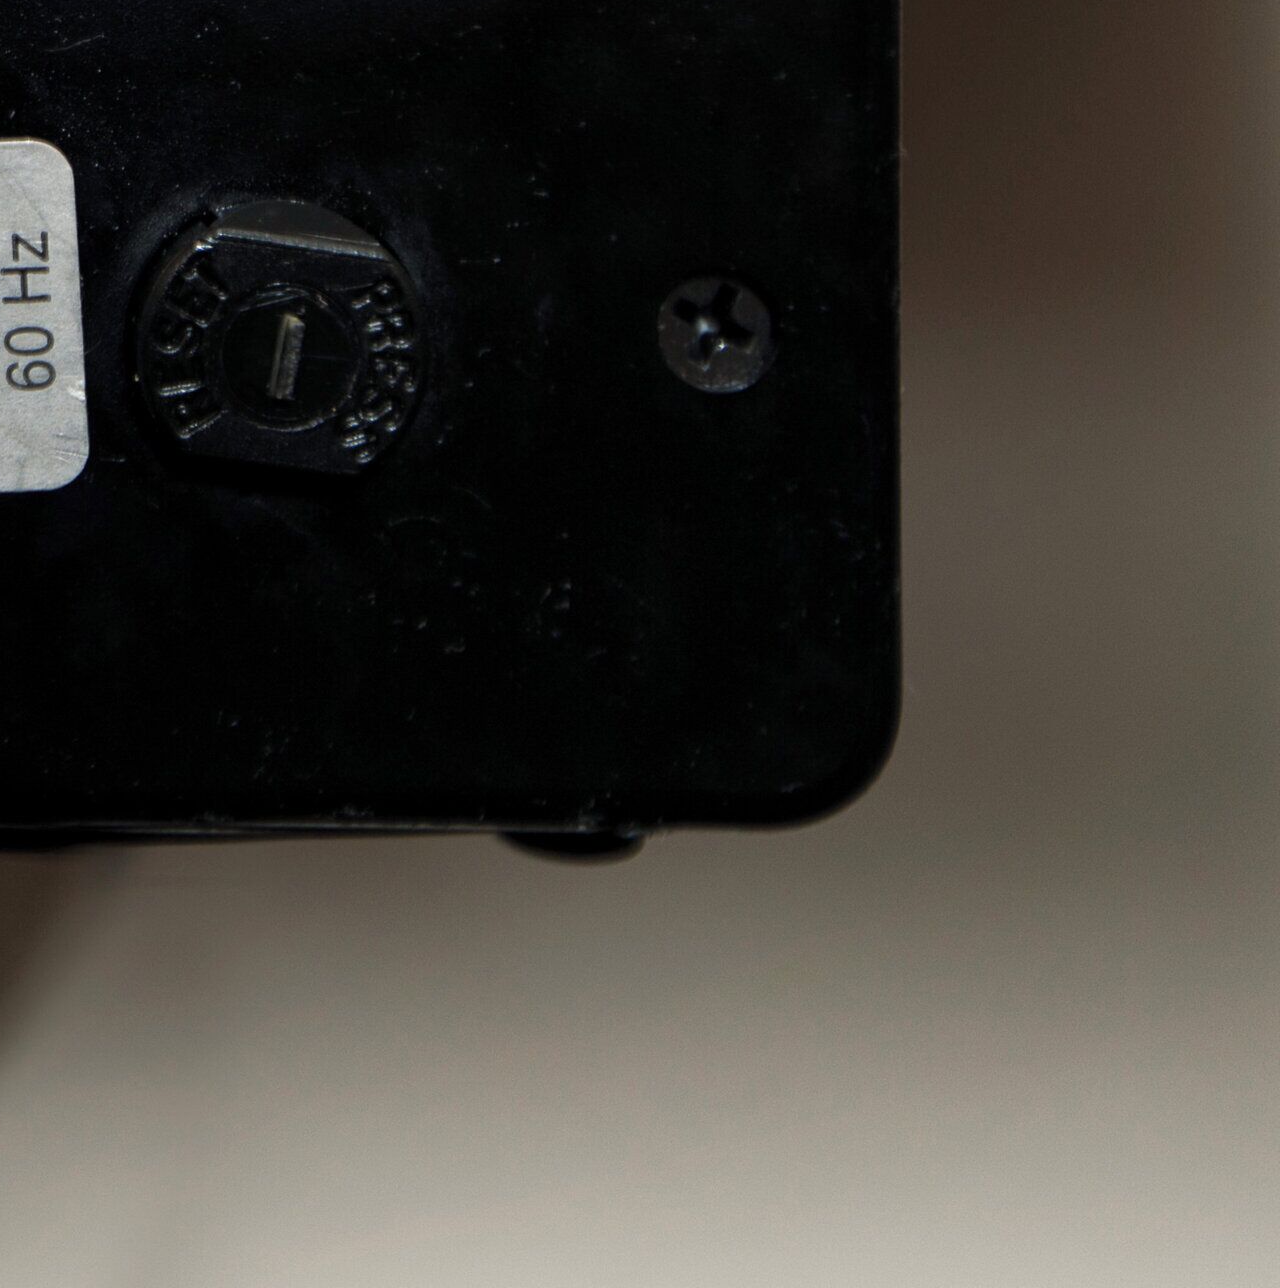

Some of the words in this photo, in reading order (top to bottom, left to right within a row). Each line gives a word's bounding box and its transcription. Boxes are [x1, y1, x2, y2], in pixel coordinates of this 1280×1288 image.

[0, 230, 52, 305] Hz
[3, 325, 57, 392] 60
[154, 260, 230, 440] RESET
[342, 278, 418, 465] PRESS
